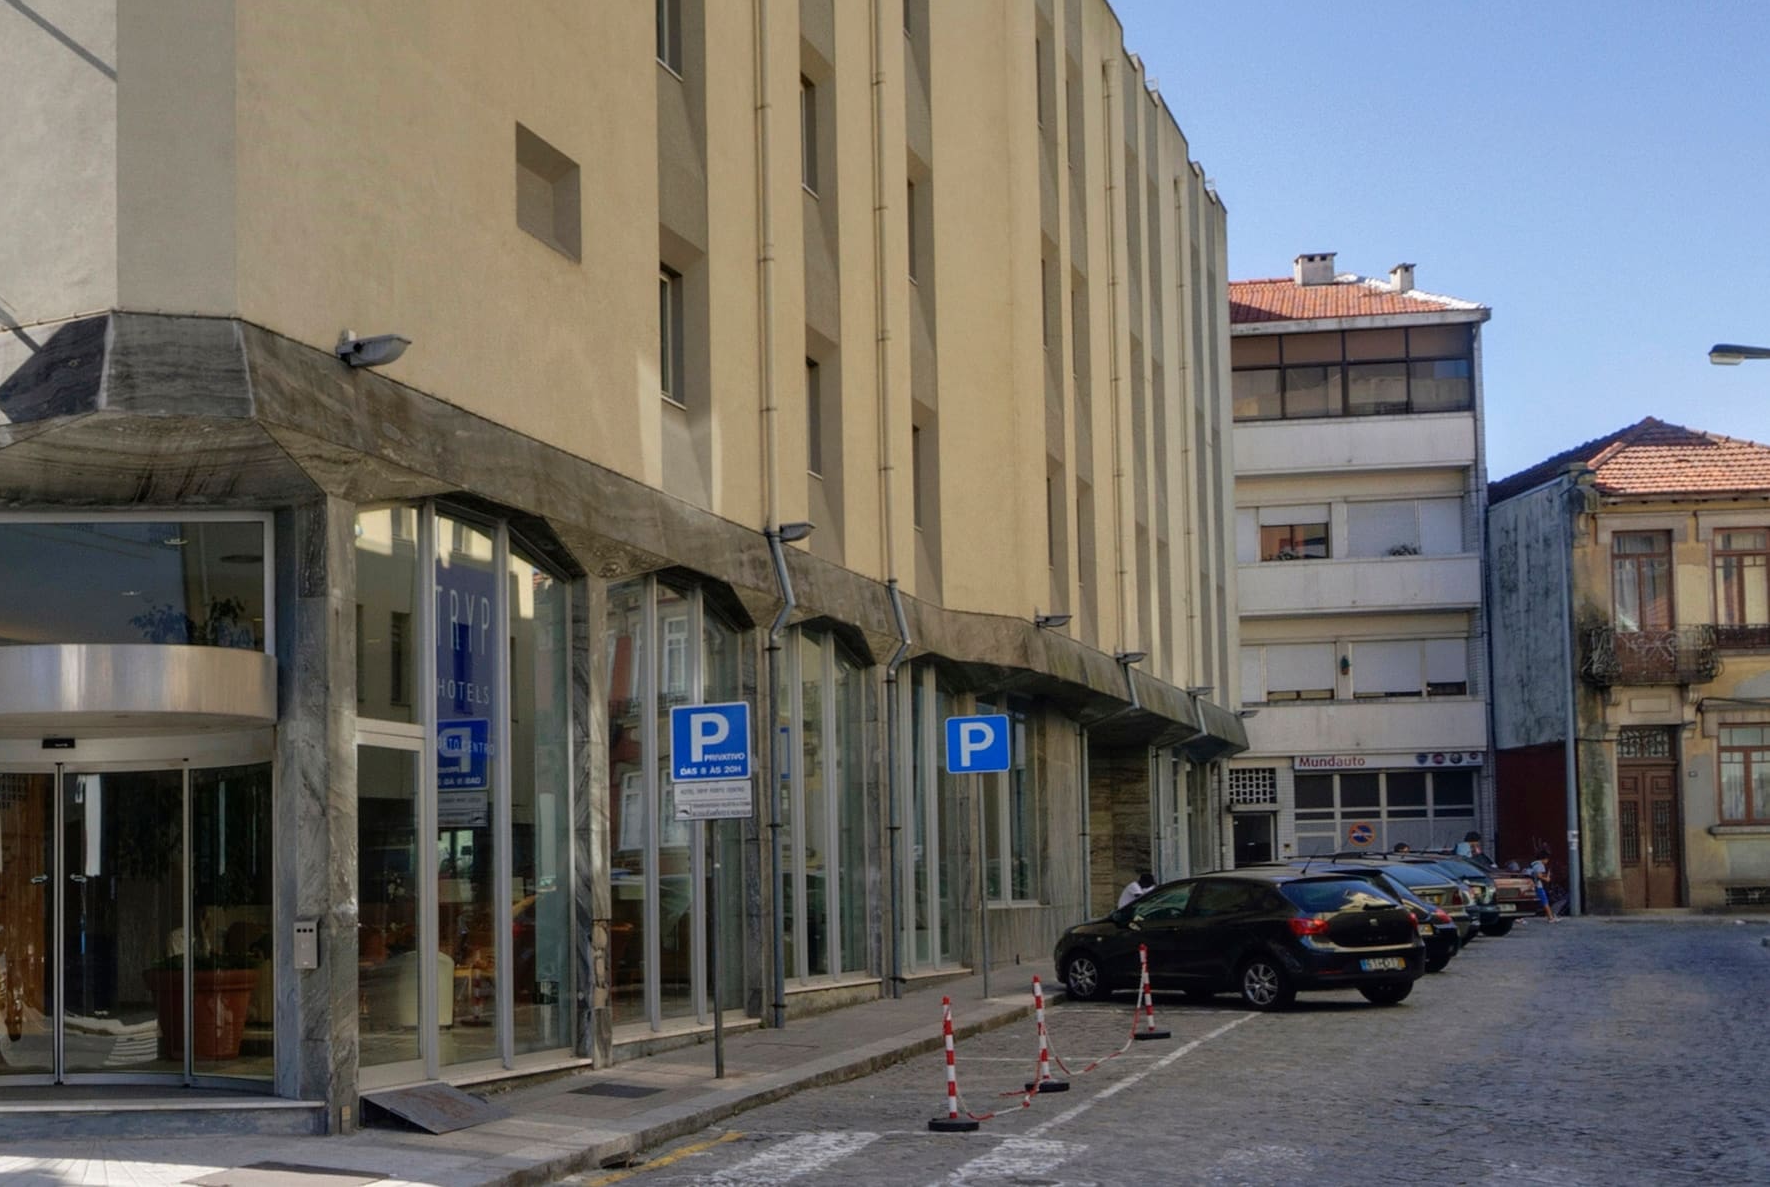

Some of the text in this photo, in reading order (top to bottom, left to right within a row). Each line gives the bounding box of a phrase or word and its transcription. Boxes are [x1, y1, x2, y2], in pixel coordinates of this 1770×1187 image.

[436, 585, 491, 656] TRYP
[437, 678, 491, 705] HOTELS
[690, 712, 730, 763] P
[959, 721, 995, 767] P
[704, 752, 746, 762] PRIVATIVO
[1298, 755, 1366, 767] Mundauto
